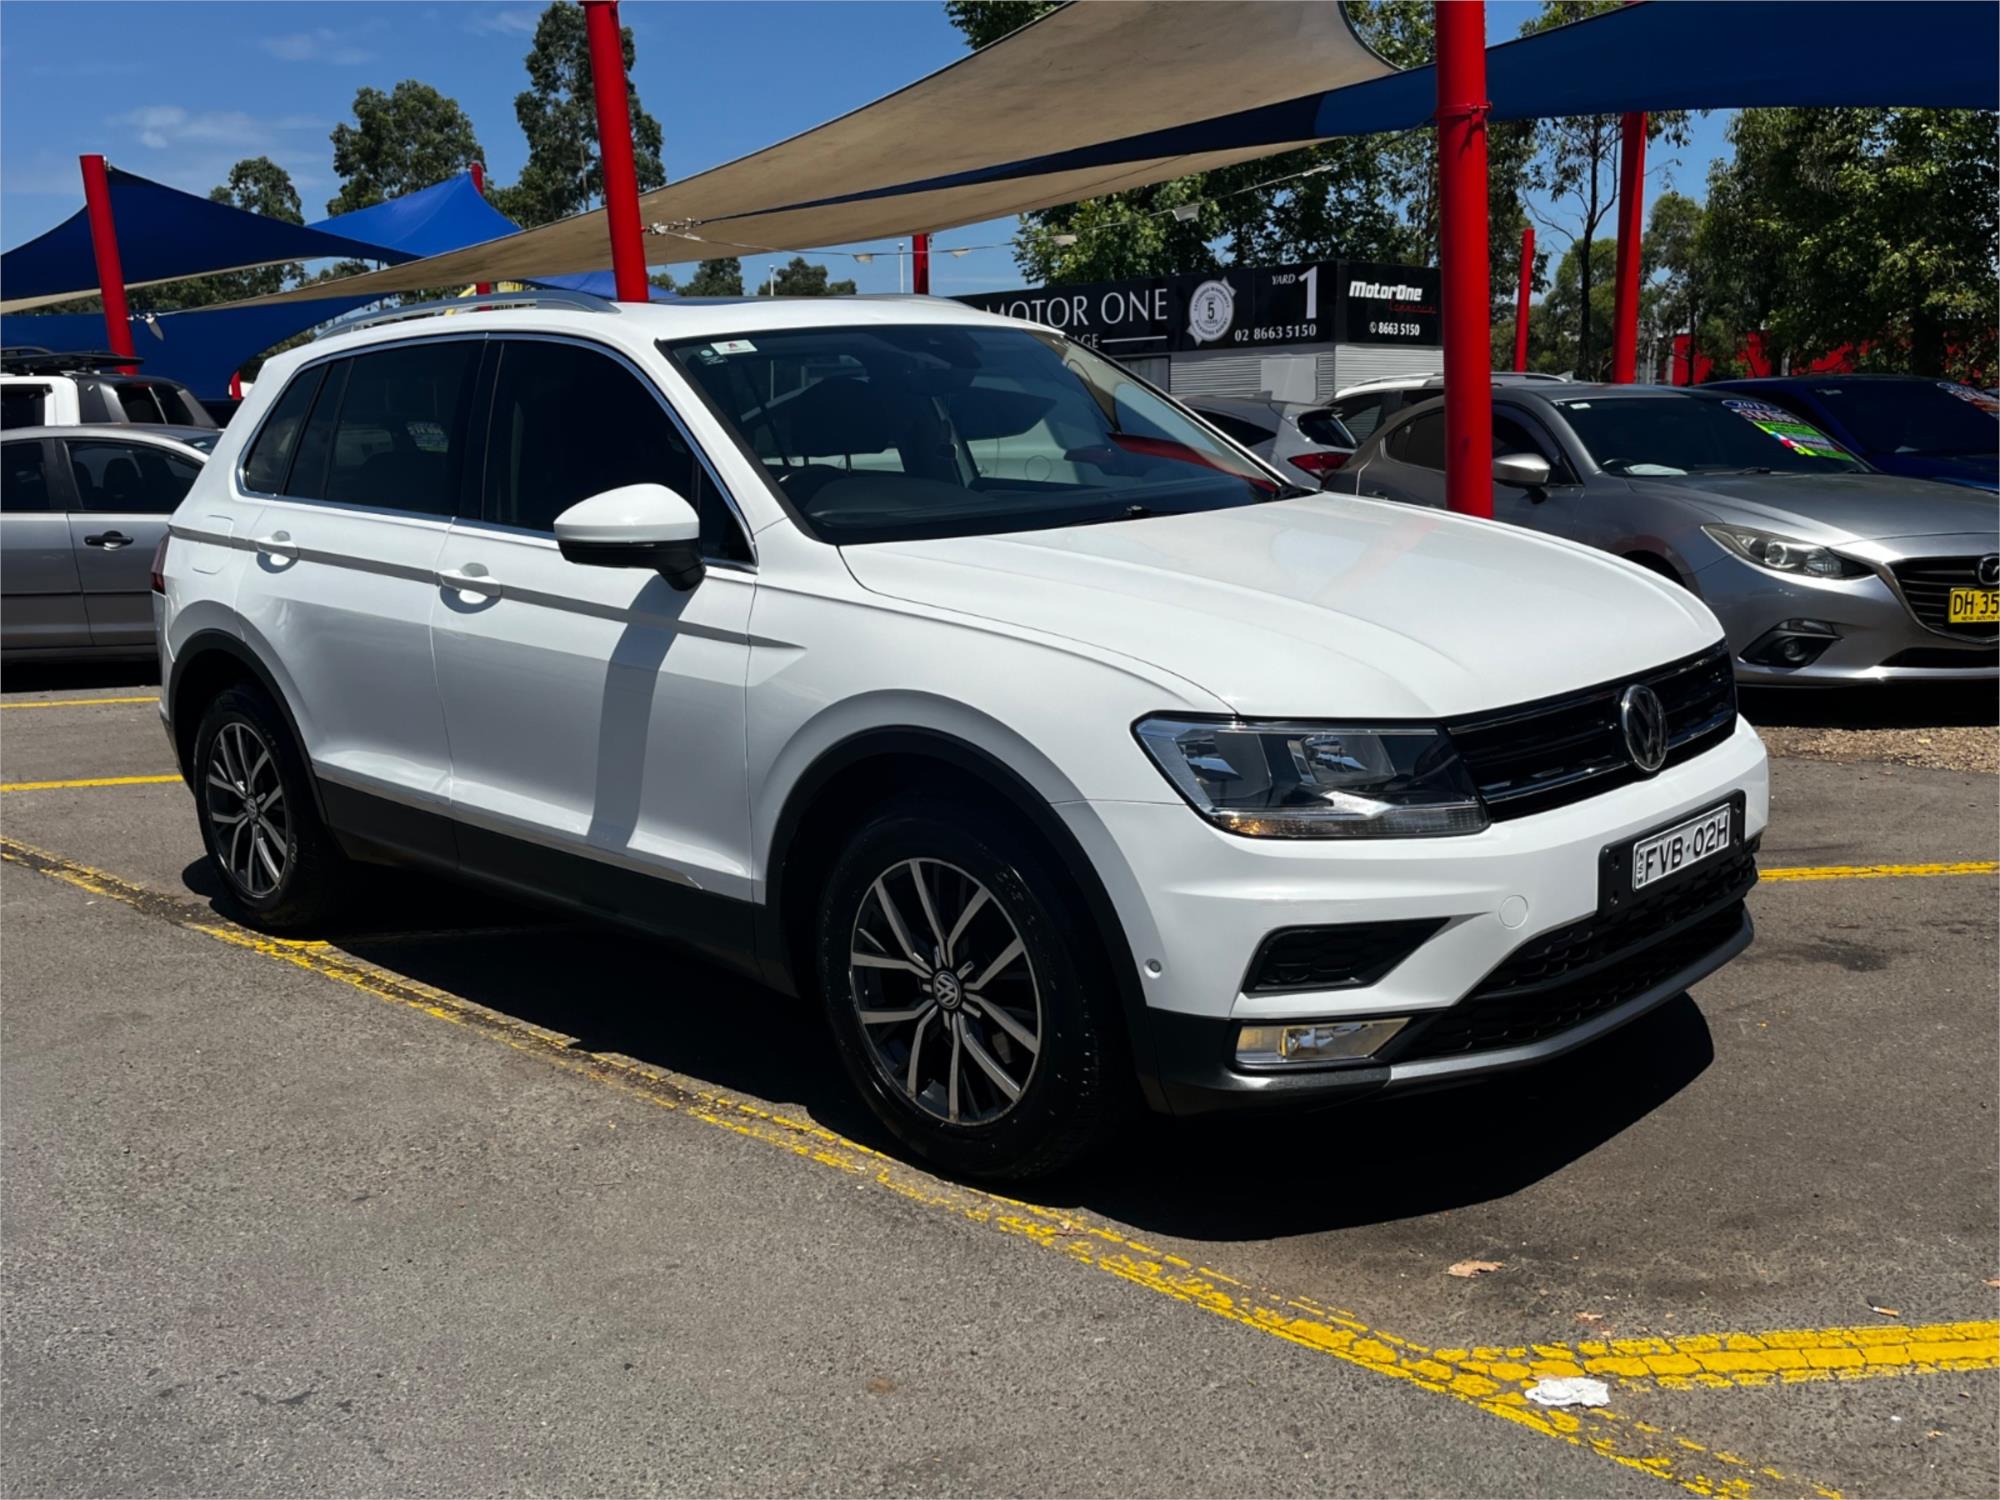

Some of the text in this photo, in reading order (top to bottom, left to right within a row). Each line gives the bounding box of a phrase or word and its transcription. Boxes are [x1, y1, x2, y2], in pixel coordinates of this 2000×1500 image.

[1271, 265, 1318, 319] YARD 1
[1349, 280, 1423, 301] MotorOne
[1101, 288, 1168, 324] ONE
[1207, 301, 1215, 320] 5
[1234, 323, 1317, 341] 02 8663 5150
[1378, 322, 1420, 336] 8663 5150
